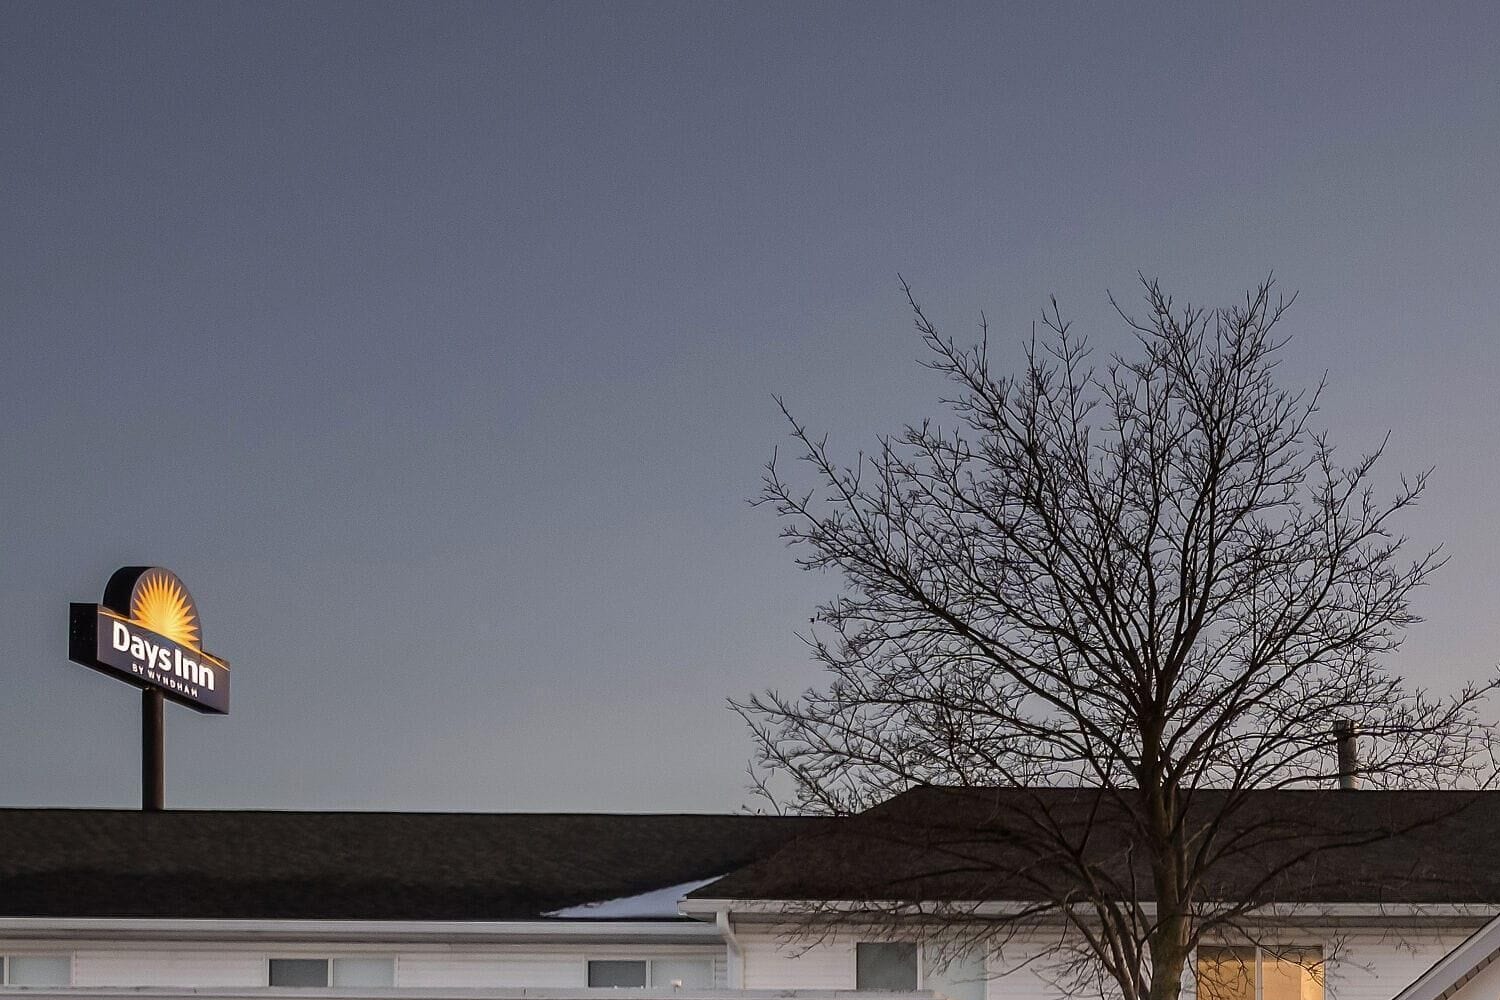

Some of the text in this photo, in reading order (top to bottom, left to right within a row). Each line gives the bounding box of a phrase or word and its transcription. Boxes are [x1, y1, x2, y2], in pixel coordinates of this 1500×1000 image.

[112, 620, 215, 691] Days Inn
[132, 663, 198, 698] BY WYNDHAM
